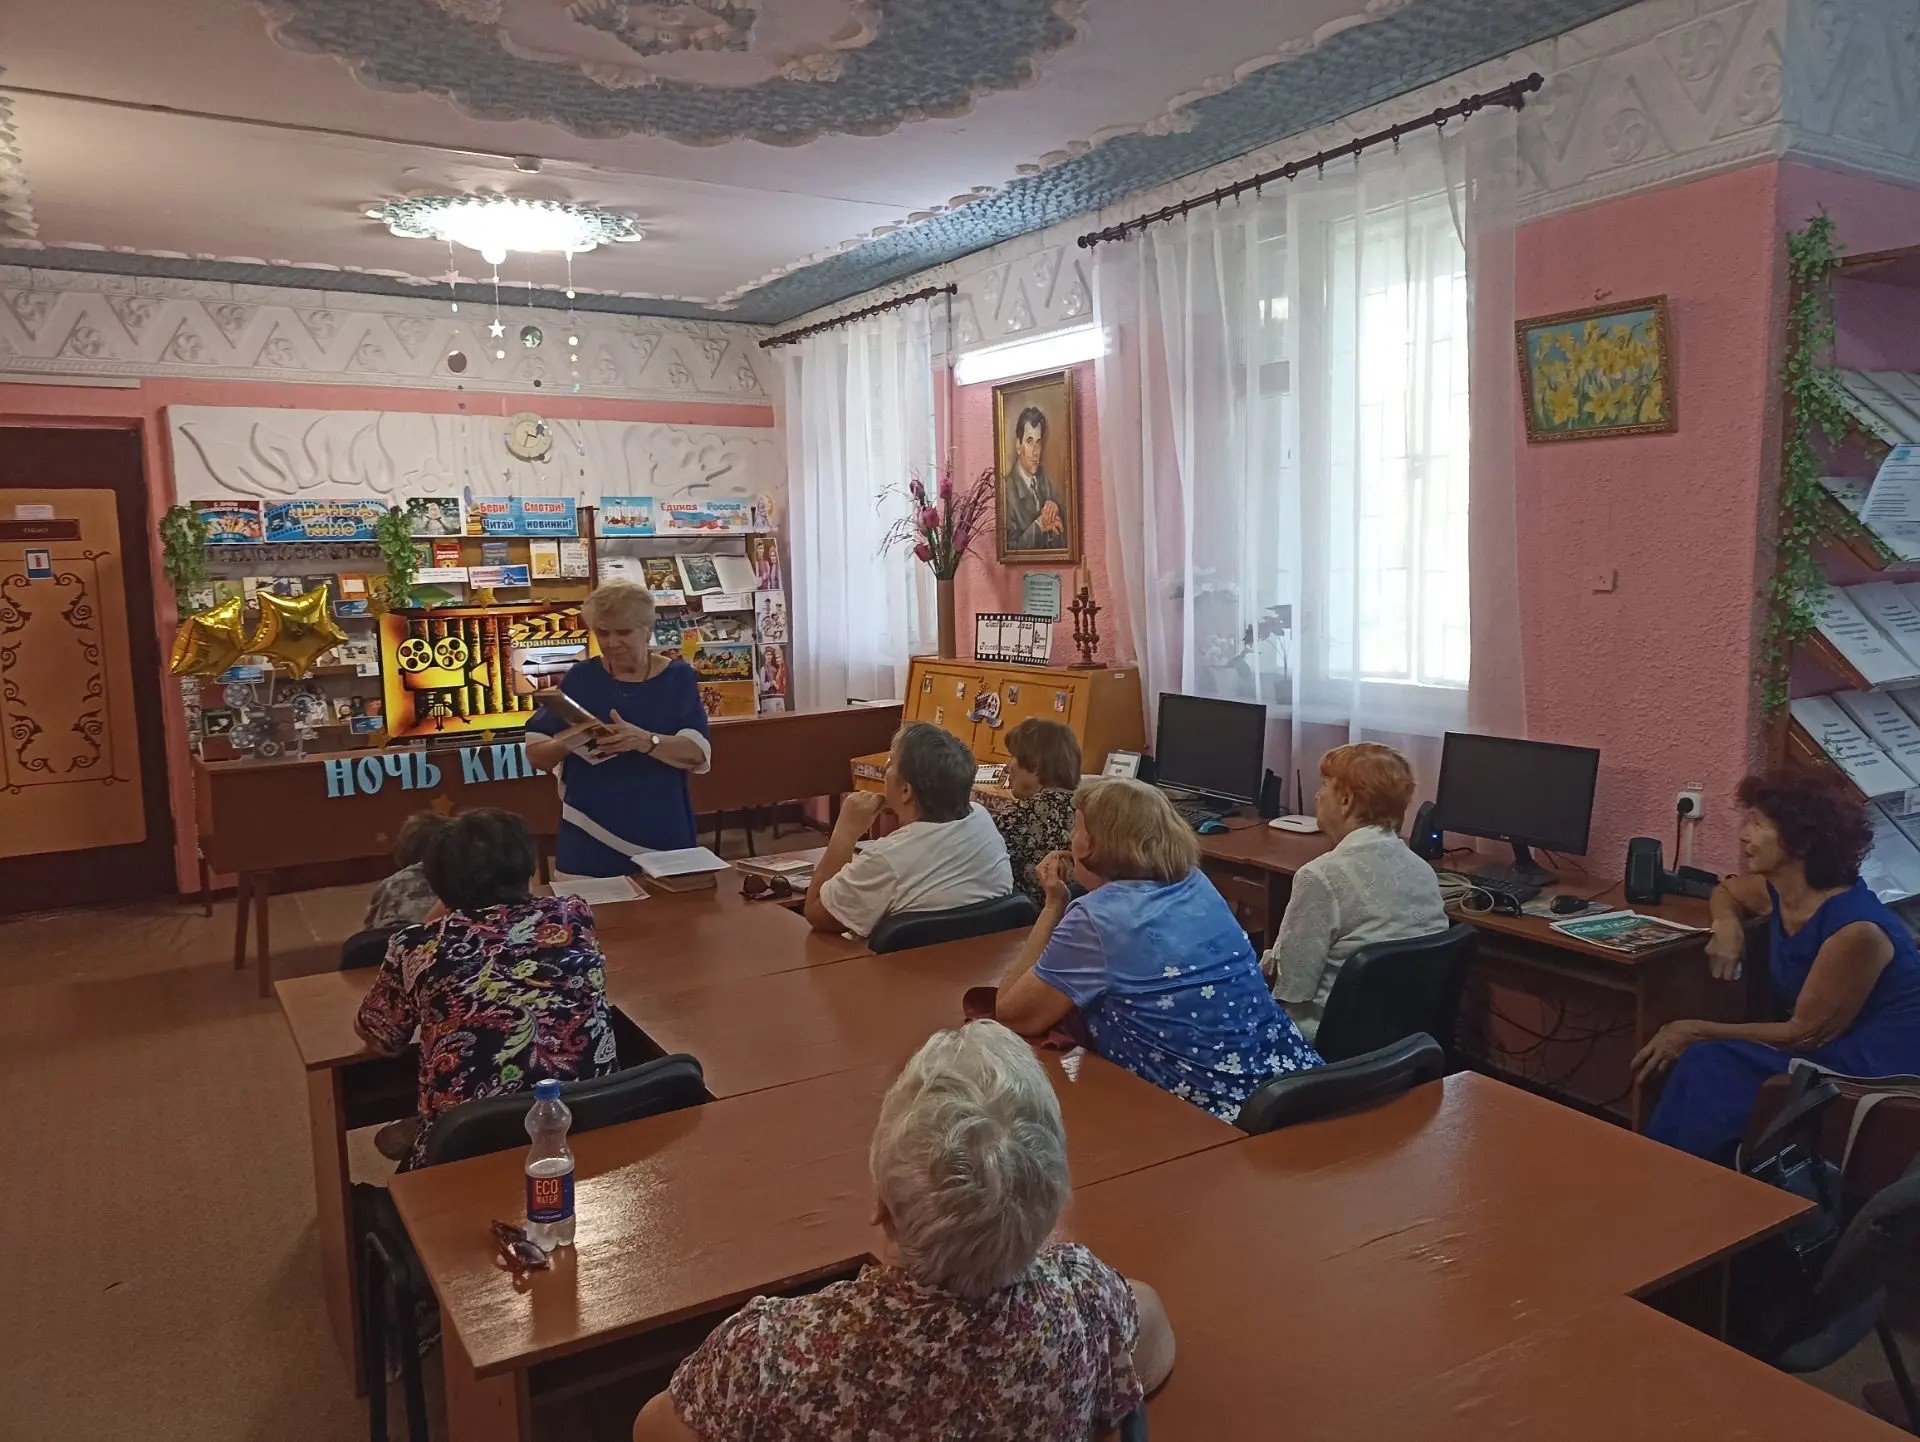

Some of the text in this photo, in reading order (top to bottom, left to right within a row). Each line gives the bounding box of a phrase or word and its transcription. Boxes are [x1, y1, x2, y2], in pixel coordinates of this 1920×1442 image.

[290, 503, 374, 518] ПЛАНЕТА
[480, 502, 564, 513] Бери! Смотри!
[660, 502, 698, 513] Единая
[305, 522, 356, 537] КИНО
[482, 519, 573, 530] Читай новинки!
[510, 636, 588, 649] Экранизация
[324, 752, 441, 798] НОЧЬ
[535, 1180, 558, 1194] ECO
[536, 1194, 558, 1204] WATER
